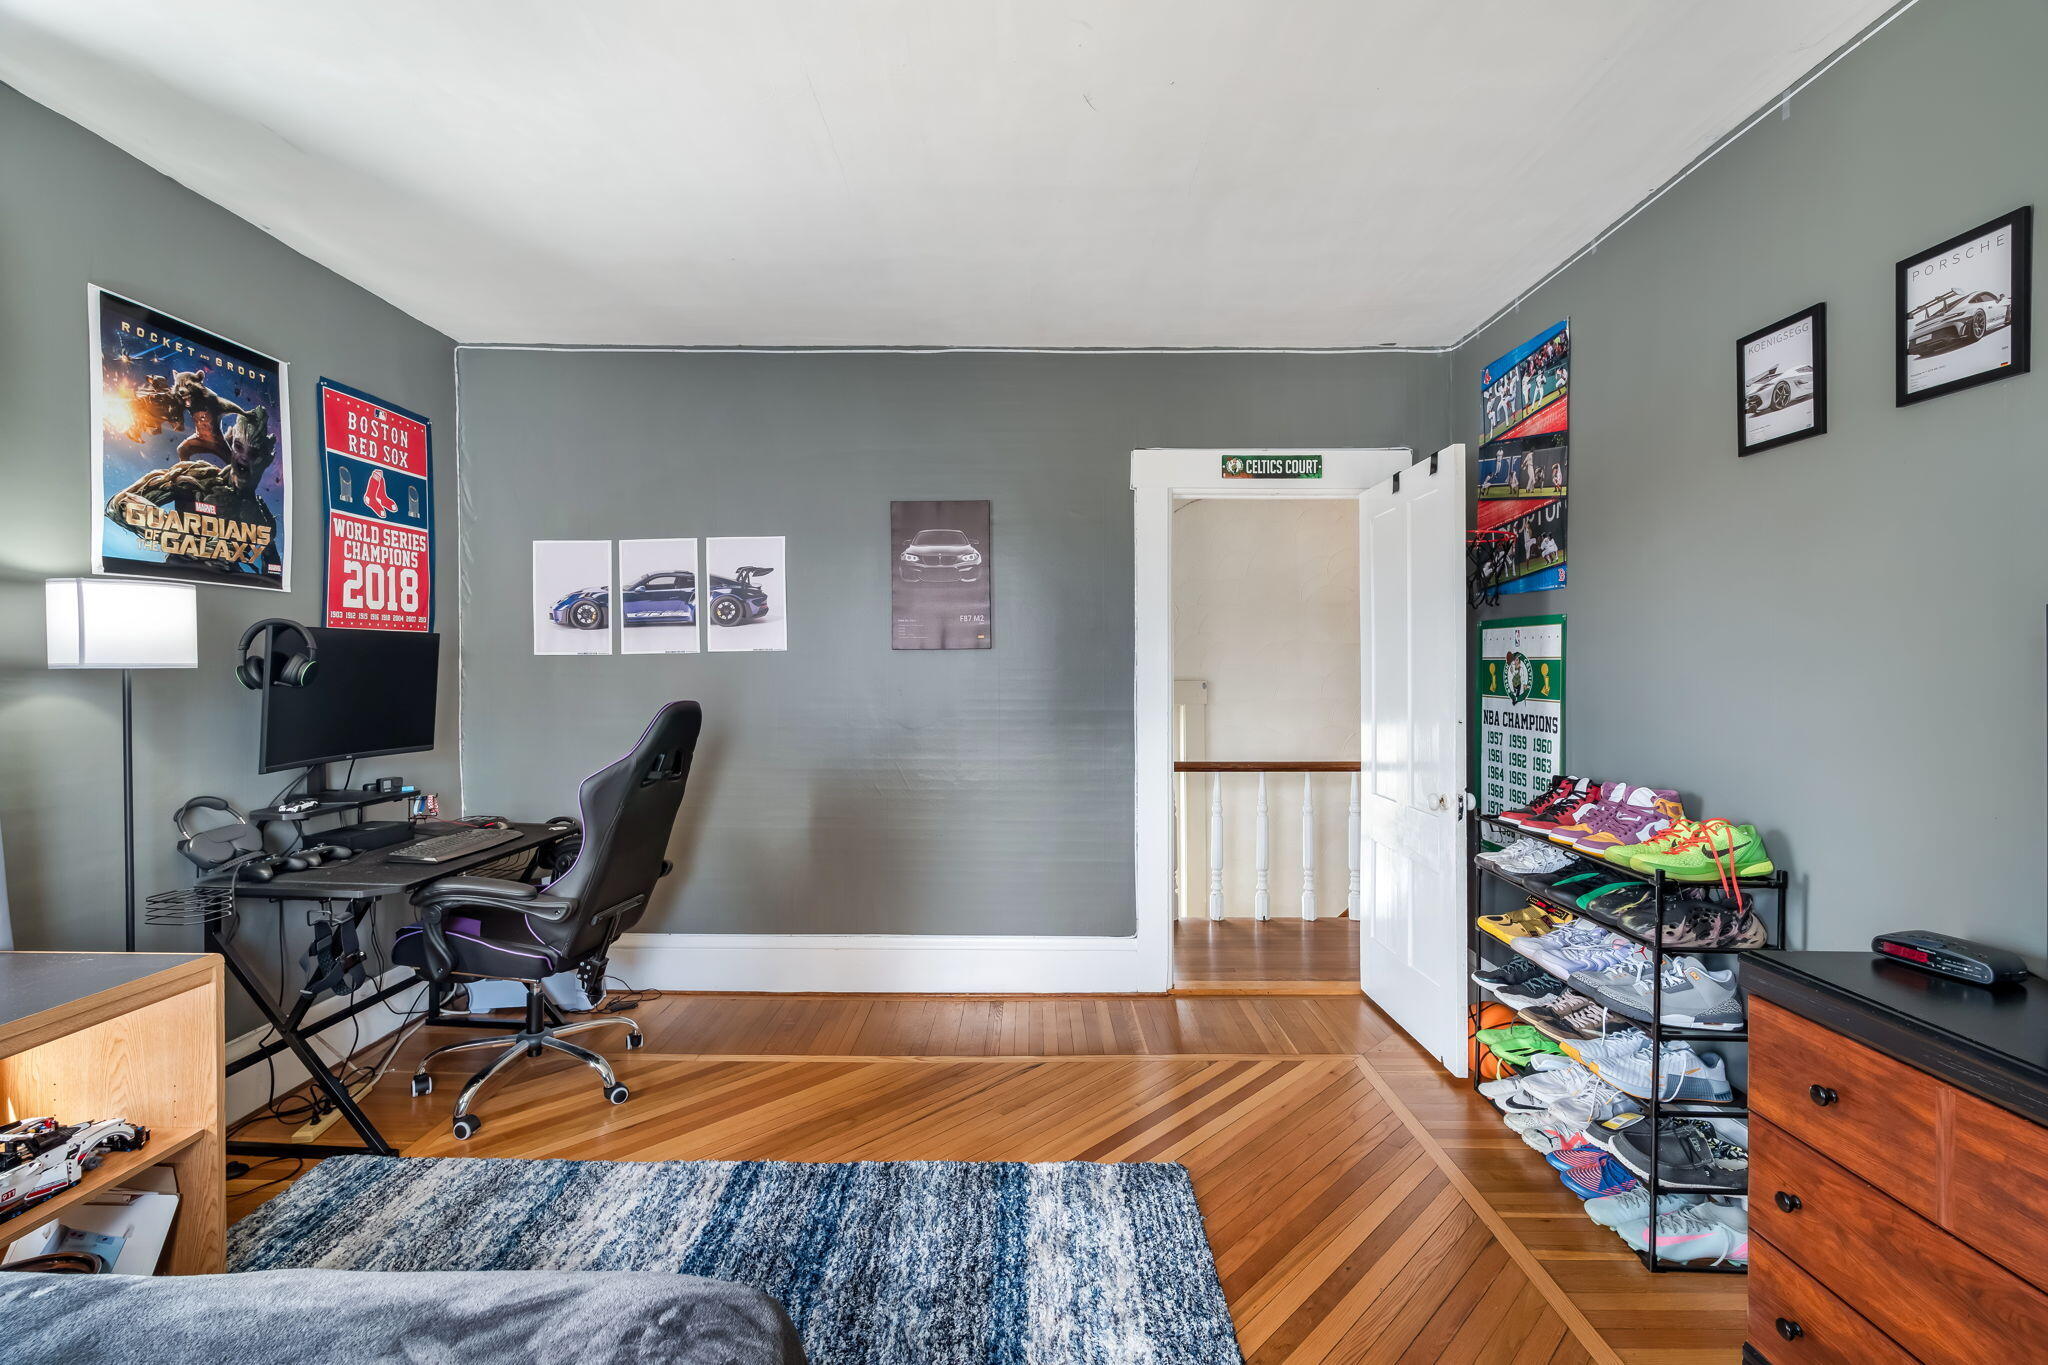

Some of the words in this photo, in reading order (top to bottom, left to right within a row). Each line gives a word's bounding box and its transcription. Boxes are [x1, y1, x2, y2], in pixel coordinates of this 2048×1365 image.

[1912, 234, 2005, 282] PORSCHE
[121, 321, 195, 356] ROCKET
[215, 357, 266, 383] GROOT
[1748, 322, 1809, 356] KOENIGSEGG
[348, 411, 409, 448] BOSTON
[348, 434, 377, 459] RED
[383, 445, 409, 469] SOX
[1246, 460, 1282, 474] CELTICS
[1285, 460, 1318, 474] COURT
[195, 502, 216, 514] MARVEL
[125, 503, 271, 545] GUARDIANS
[144, 529, 159, 541] OF
[333, 517, 380, 544] WORLD
[383, 528, 427, 552] SERIES
[136, 539, 161, 552] THE
[161, 531, 266, 563] GALAXY
[343, 540, 418, 568] CHAMPIONS
[342, 560, 419, 612] 2018
[959, 614, 972, 622] F87
[973, 614, 985, 622] M2
[1483, 709, 1500, 727] NBA
[1502, 711, 1559, 734] CHAMPIONS
[1487, 730, 1503, 746] 1957
[1509, 733, 1527, 750] 1959
[1532, 737, 1552, 754] 1960
[1488, 748, 1503, 764] 1961
[1508, 752, 1527, 769] 1962
[1532, 756, 1552, 774] 1963
[1487, 765, 1504, 781] 1964
[1509, 770, 1527, 787] 1965
[1487, 783, 1503, 799] 1968
[1509, 788, 1527, 805] 1969
